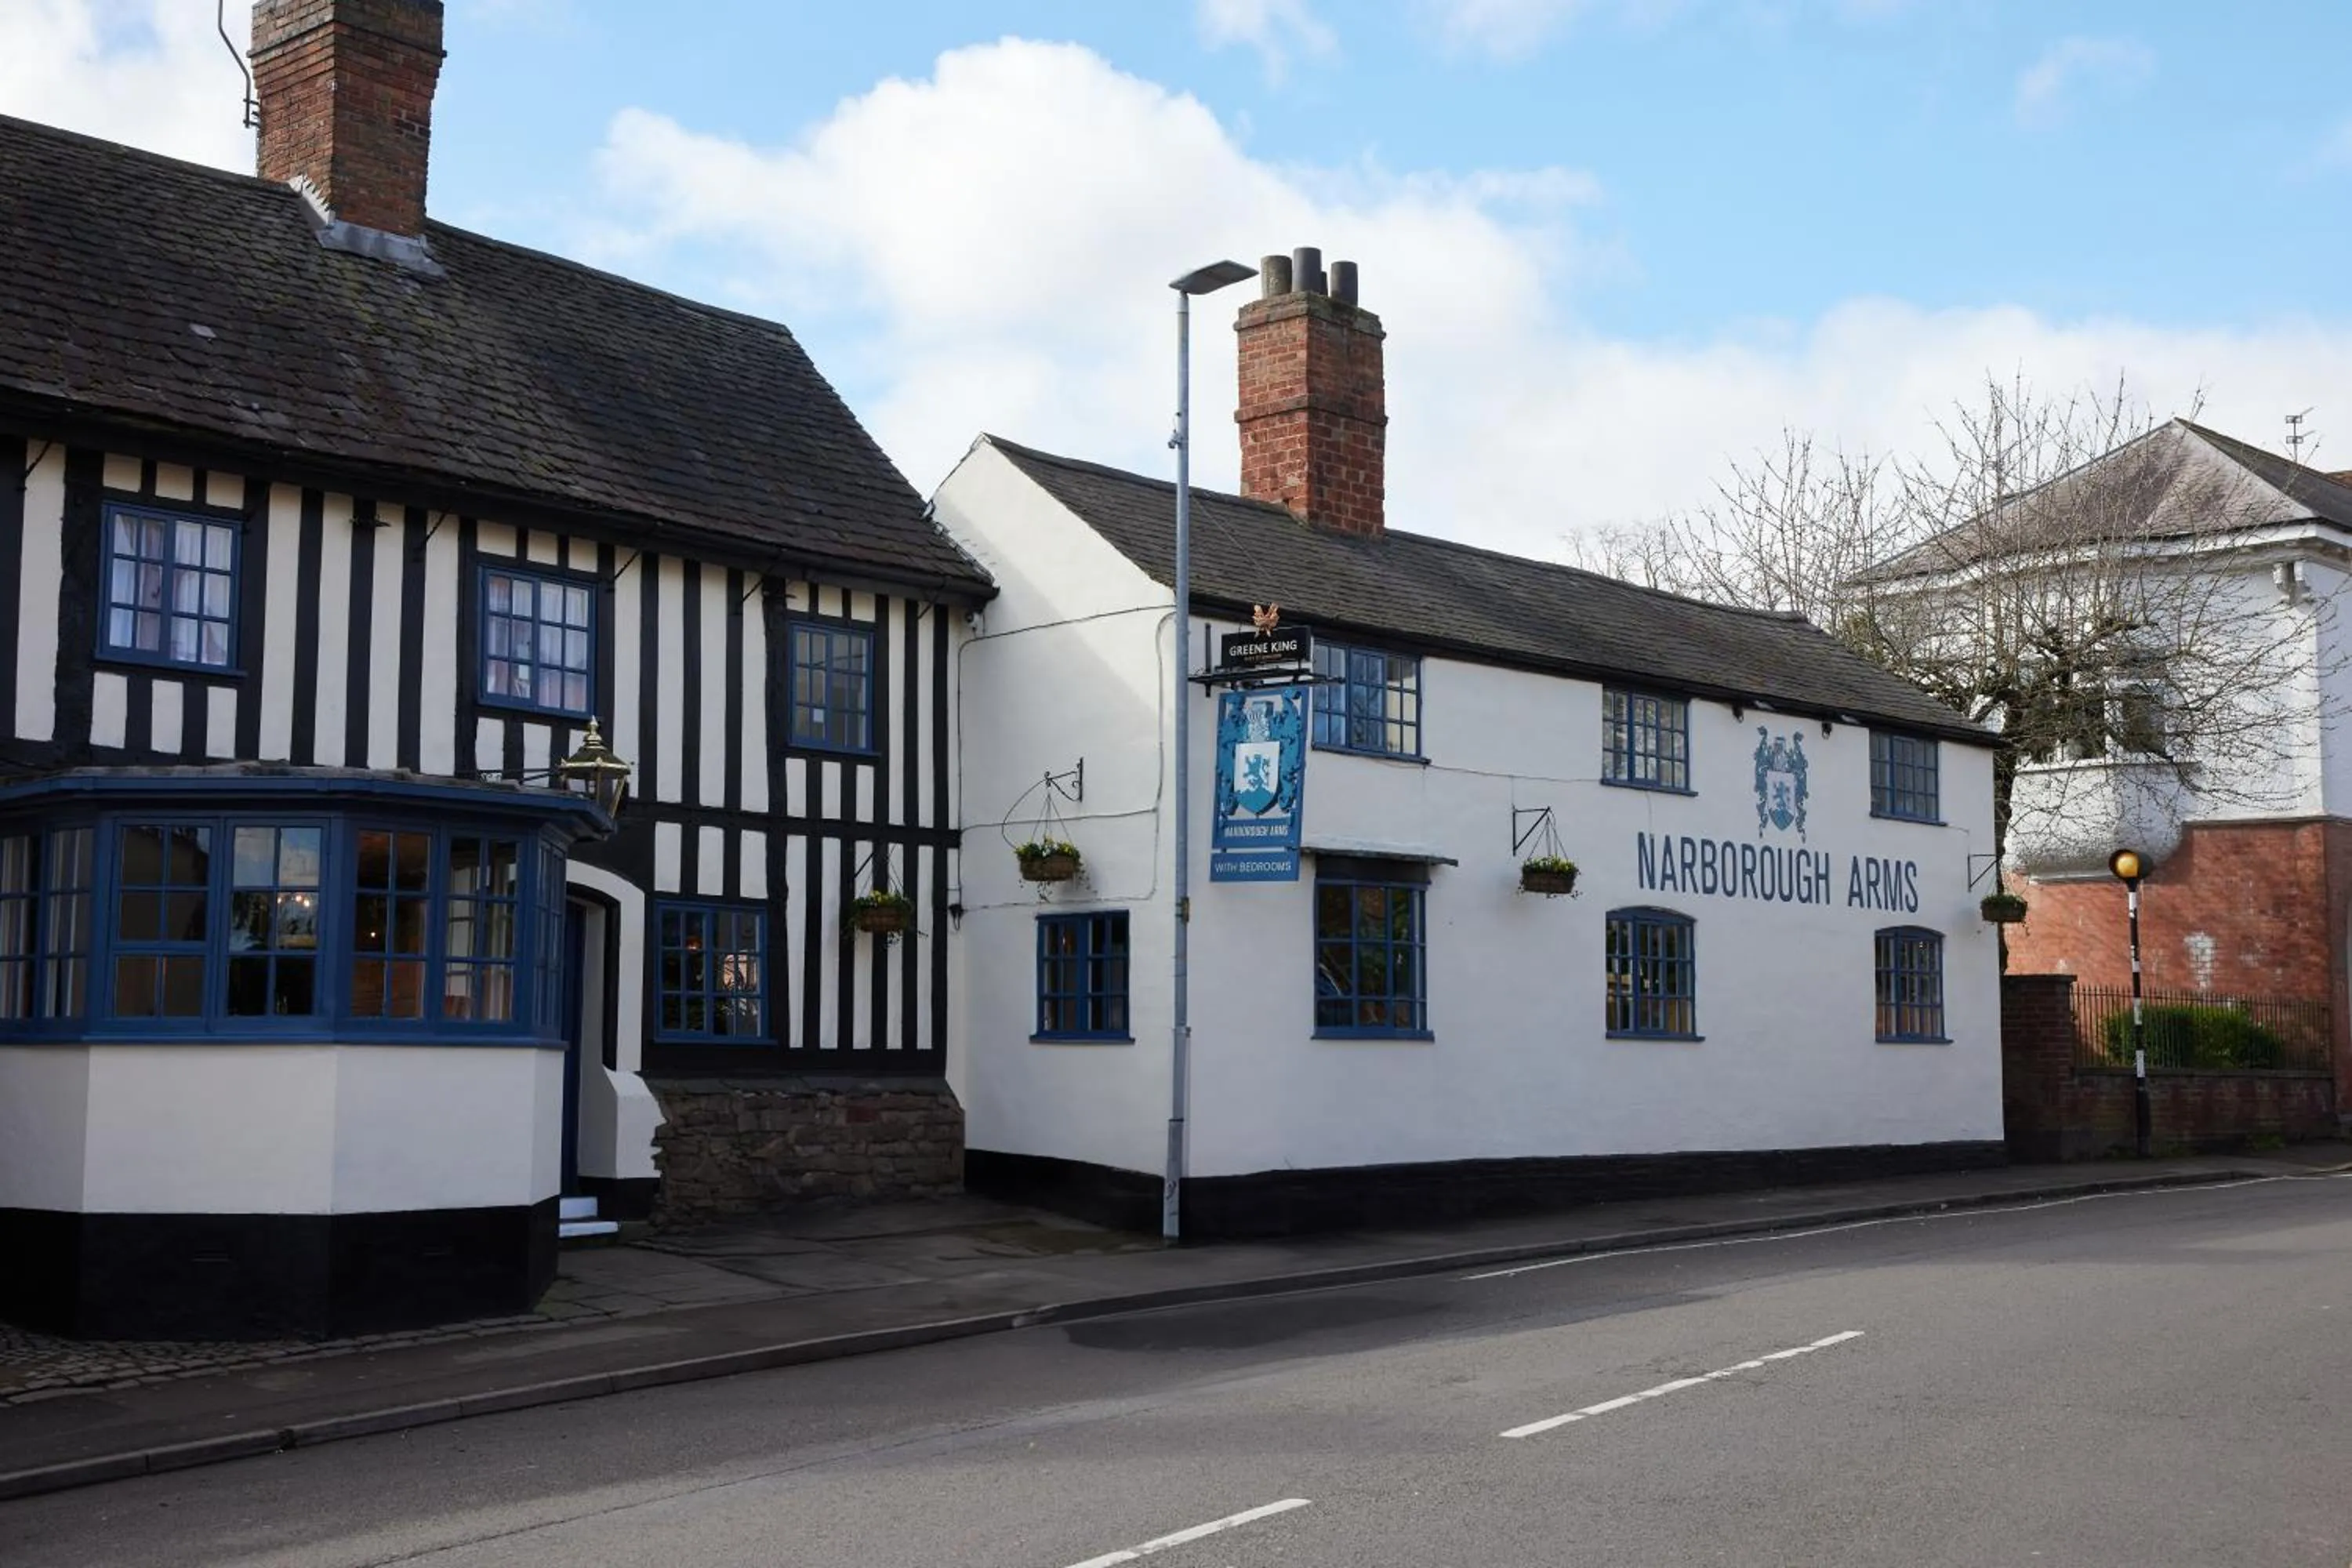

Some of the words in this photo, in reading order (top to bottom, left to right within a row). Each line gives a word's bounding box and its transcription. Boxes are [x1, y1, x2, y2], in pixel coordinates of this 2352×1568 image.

[1229, 643, 1269, 656] GREENE
[1270, 640, 1298, 652] KING
[1214, 862, 1237, 873] WITH
[1239, 861, 1292, 873] BEDROOMS
[1637, 831, 1831, 906] NARBOROUGH
[1847, 855, 1918, 913] ARMS
